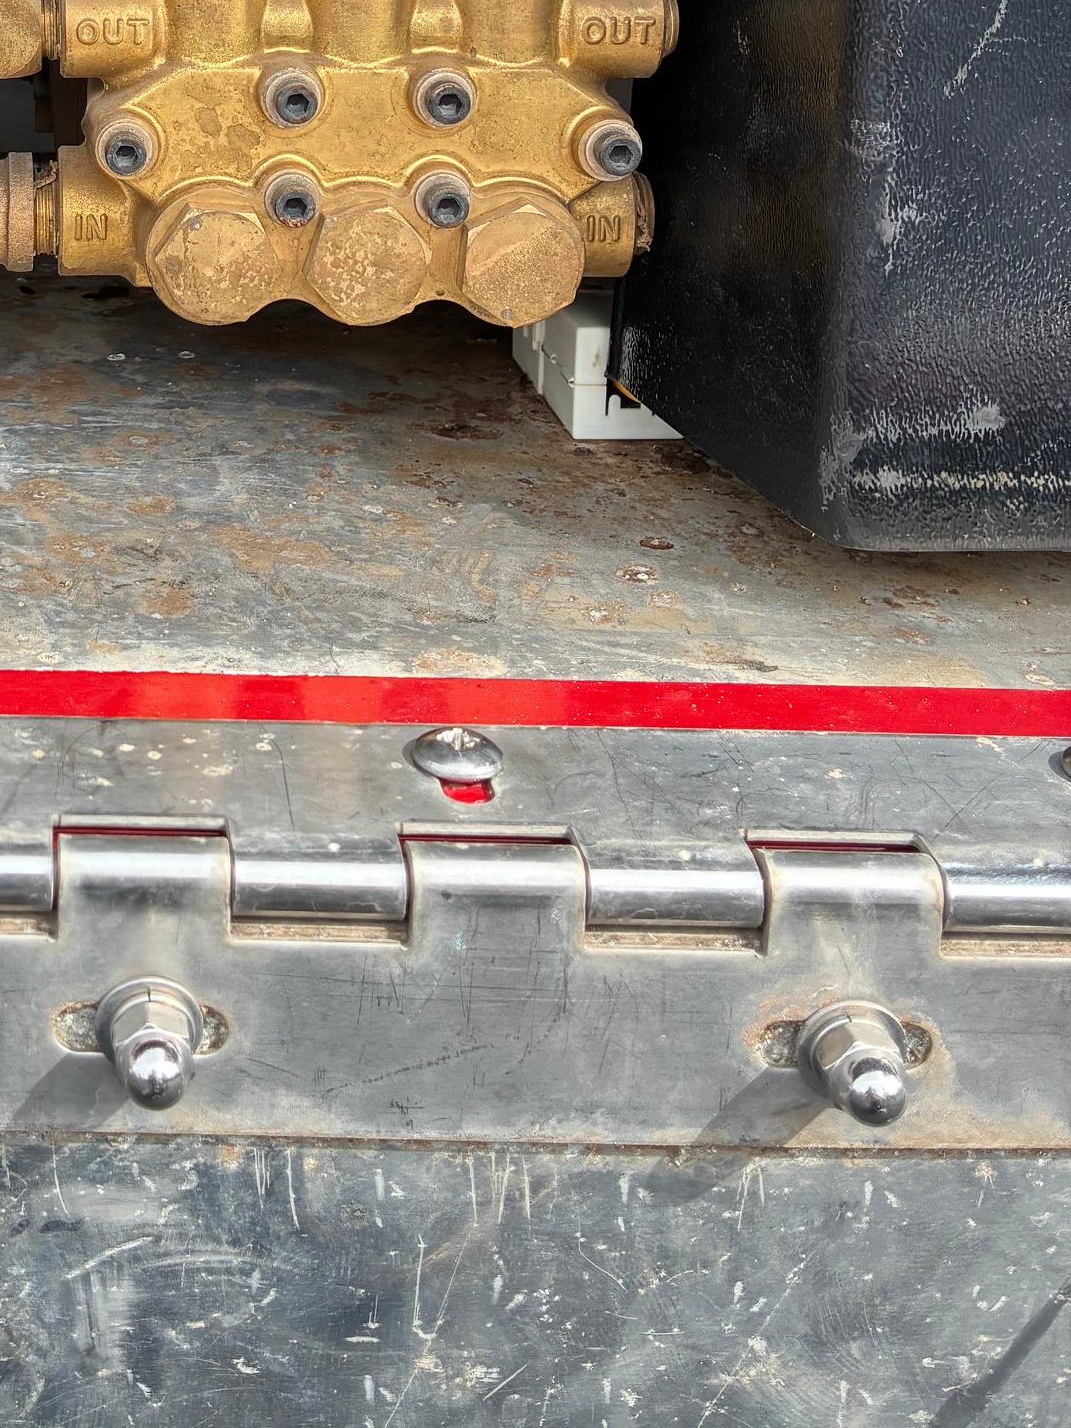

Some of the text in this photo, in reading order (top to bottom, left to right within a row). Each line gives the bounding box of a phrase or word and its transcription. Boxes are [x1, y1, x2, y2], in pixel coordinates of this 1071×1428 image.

[76, 17, 150, 46] OUT
[581, 16, 656, 45] OUT
[74, 213, 108, 241] IN
[586, 214, 621, 242] IN
